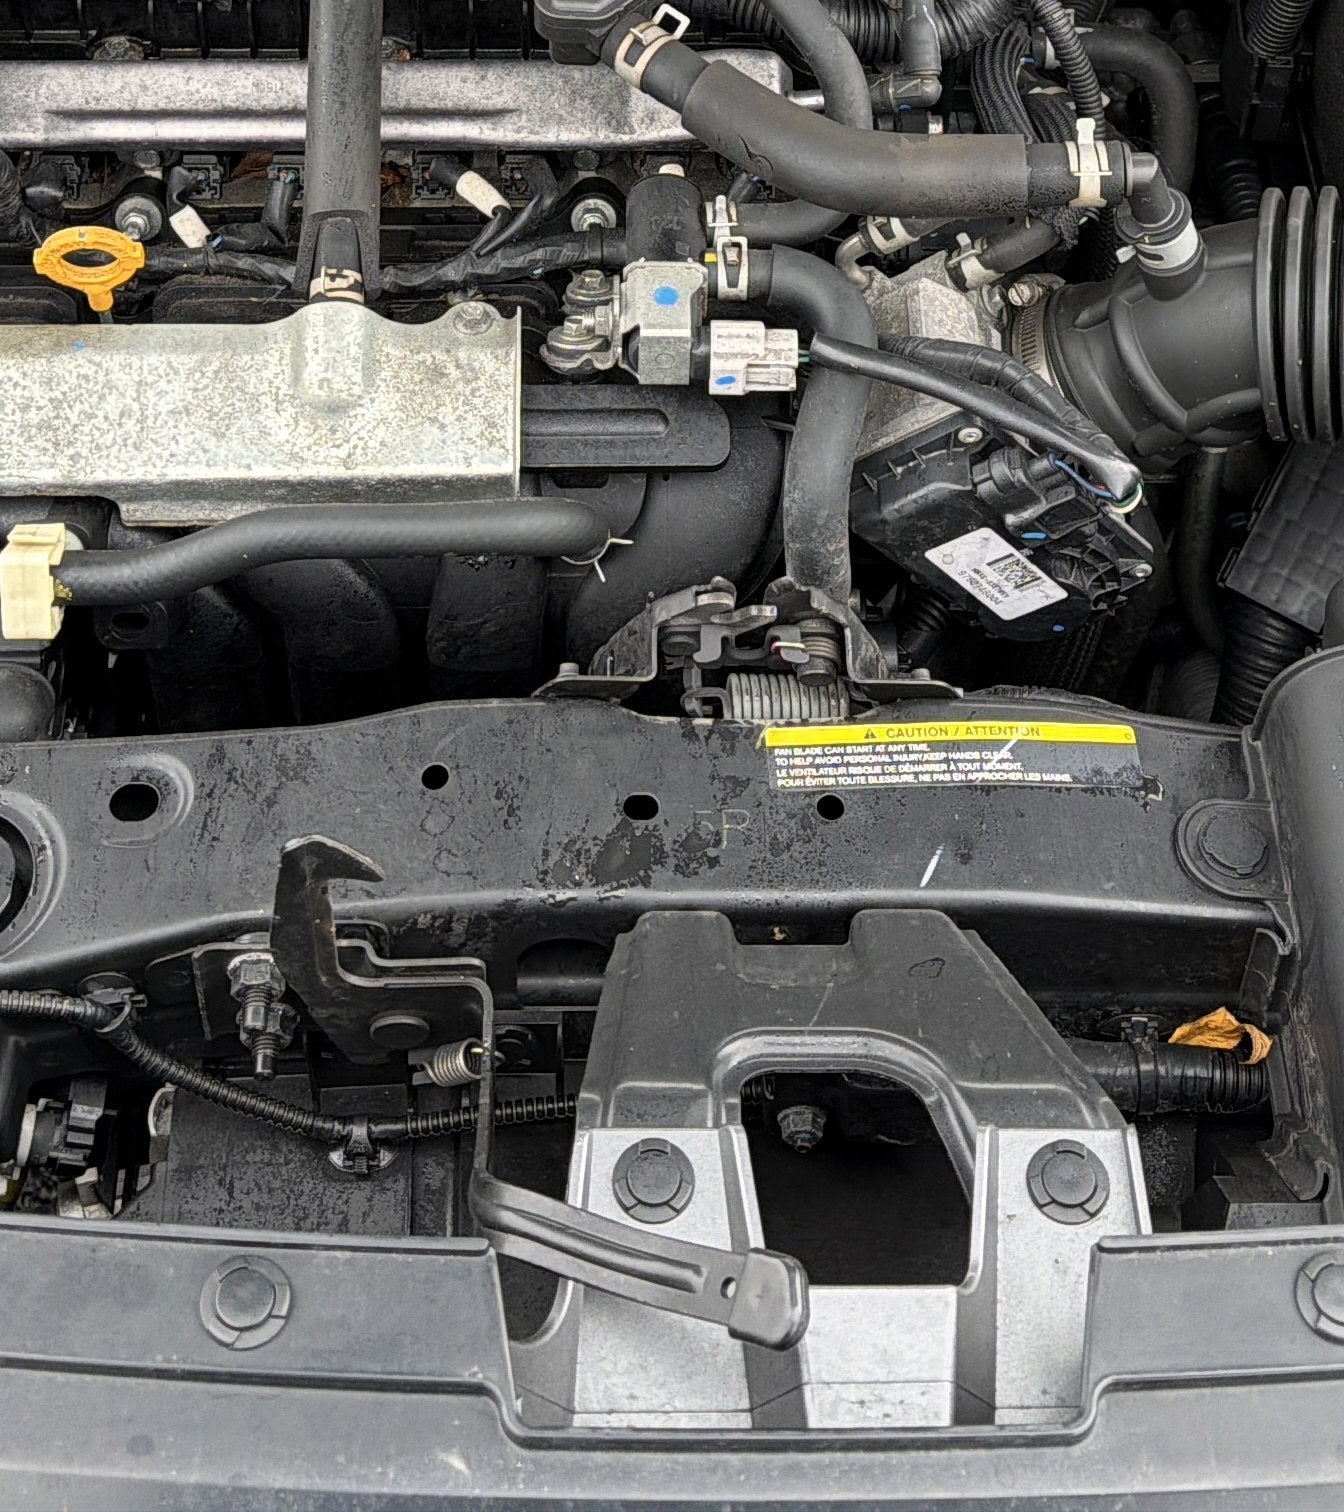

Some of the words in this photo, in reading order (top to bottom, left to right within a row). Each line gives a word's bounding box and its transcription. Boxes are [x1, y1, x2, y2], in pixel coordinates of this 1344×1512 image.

[886, 726, 949, 738] CAUTION
[965, 725, 1041, 737] ATTENTION
[774, 747, 792, 756] FAN
[794, 746, 823, 756] BLADE
[824, 746, 844, 755] CAN
[846, 745, 873, 754] START
[875, 744, 886, 753] AT
[888, 744, 907, 753] ANY
[908, 743, 930, 752] TIME.
[775, 757, 788, 767] TO
[790, 757, 813, 766] HELP
[814, 756, 842, 765] AVOID
[843, 754, 892, 764] PERSONAL
[948, 751, 980, 760] HANDS
[776, 769, 789, 777] LE
[790, 766, 847, 776] VENTILATEUR
[848, 765, 882, 775] RISQUE
[884, 764, 897, 773] DE
[898, 762, 947, 772] DÉMARRER
[958, 762, 980, 771] TOUT
[777, 778, 804, 787] POUR
[805, 776, 836, 786] ÉVITER
[837, 776, 866, 785] TOUTE
[919, 773, 931, 782] NE
[933, 773, 951, 781] PAS
[952, 772, 967, 781] EN
[968, 772, 1024, 781] APPROCHER
[1026, 772, 1041, 781] LES
